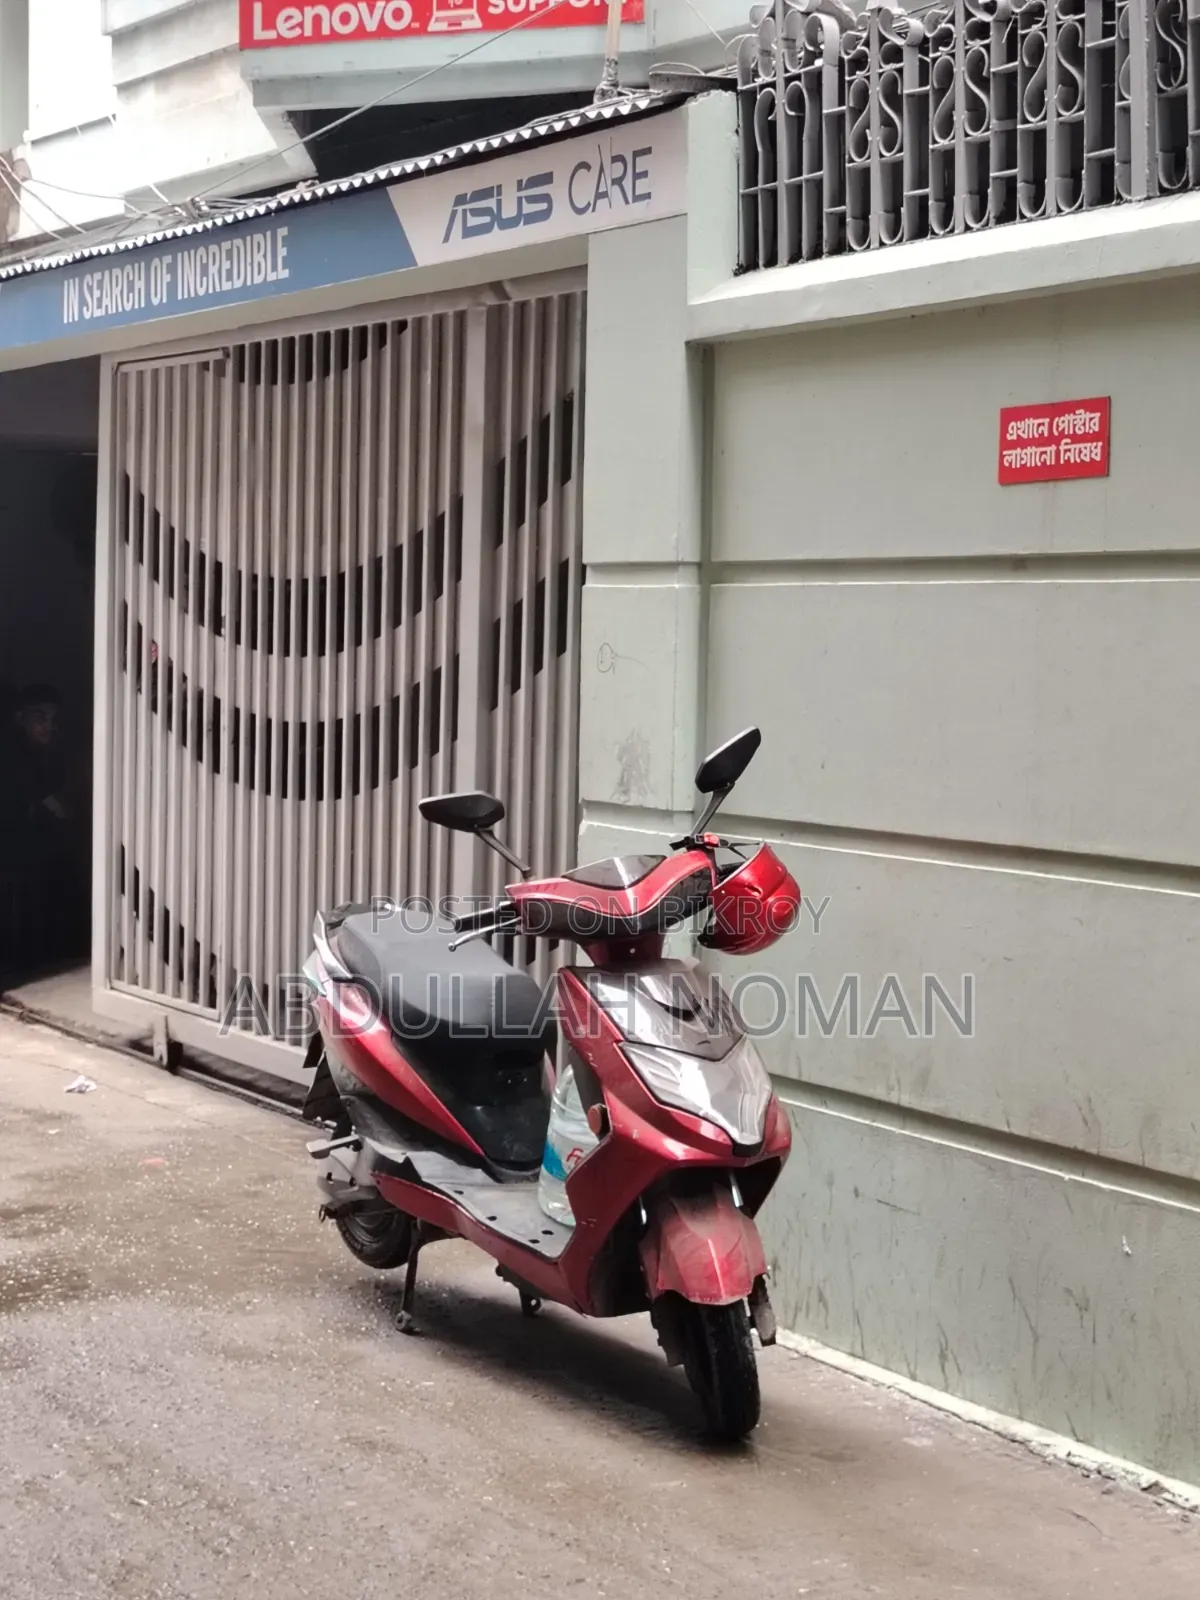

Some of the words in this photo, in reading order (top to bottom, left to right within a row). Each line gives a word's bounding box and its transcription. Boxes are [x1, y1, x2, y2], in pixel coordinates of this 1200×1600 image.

[253, 0, 413, 40] Lenovo
[442, 171, 554, 244] ASUS
[568, 137, 652, 215] CARE
[63, 277, 79, 324] IN
[83, 261, 145, 320] SEARCH
[151, 254, 172, 306] OF
[177, 226, 289, 300] INCREDIBLE
[1006, 418, 1050, 440] এখানে
[1002, 444, 1056, 468] লাগানো
[1059, 438, 1102, 464] নিষেধ
